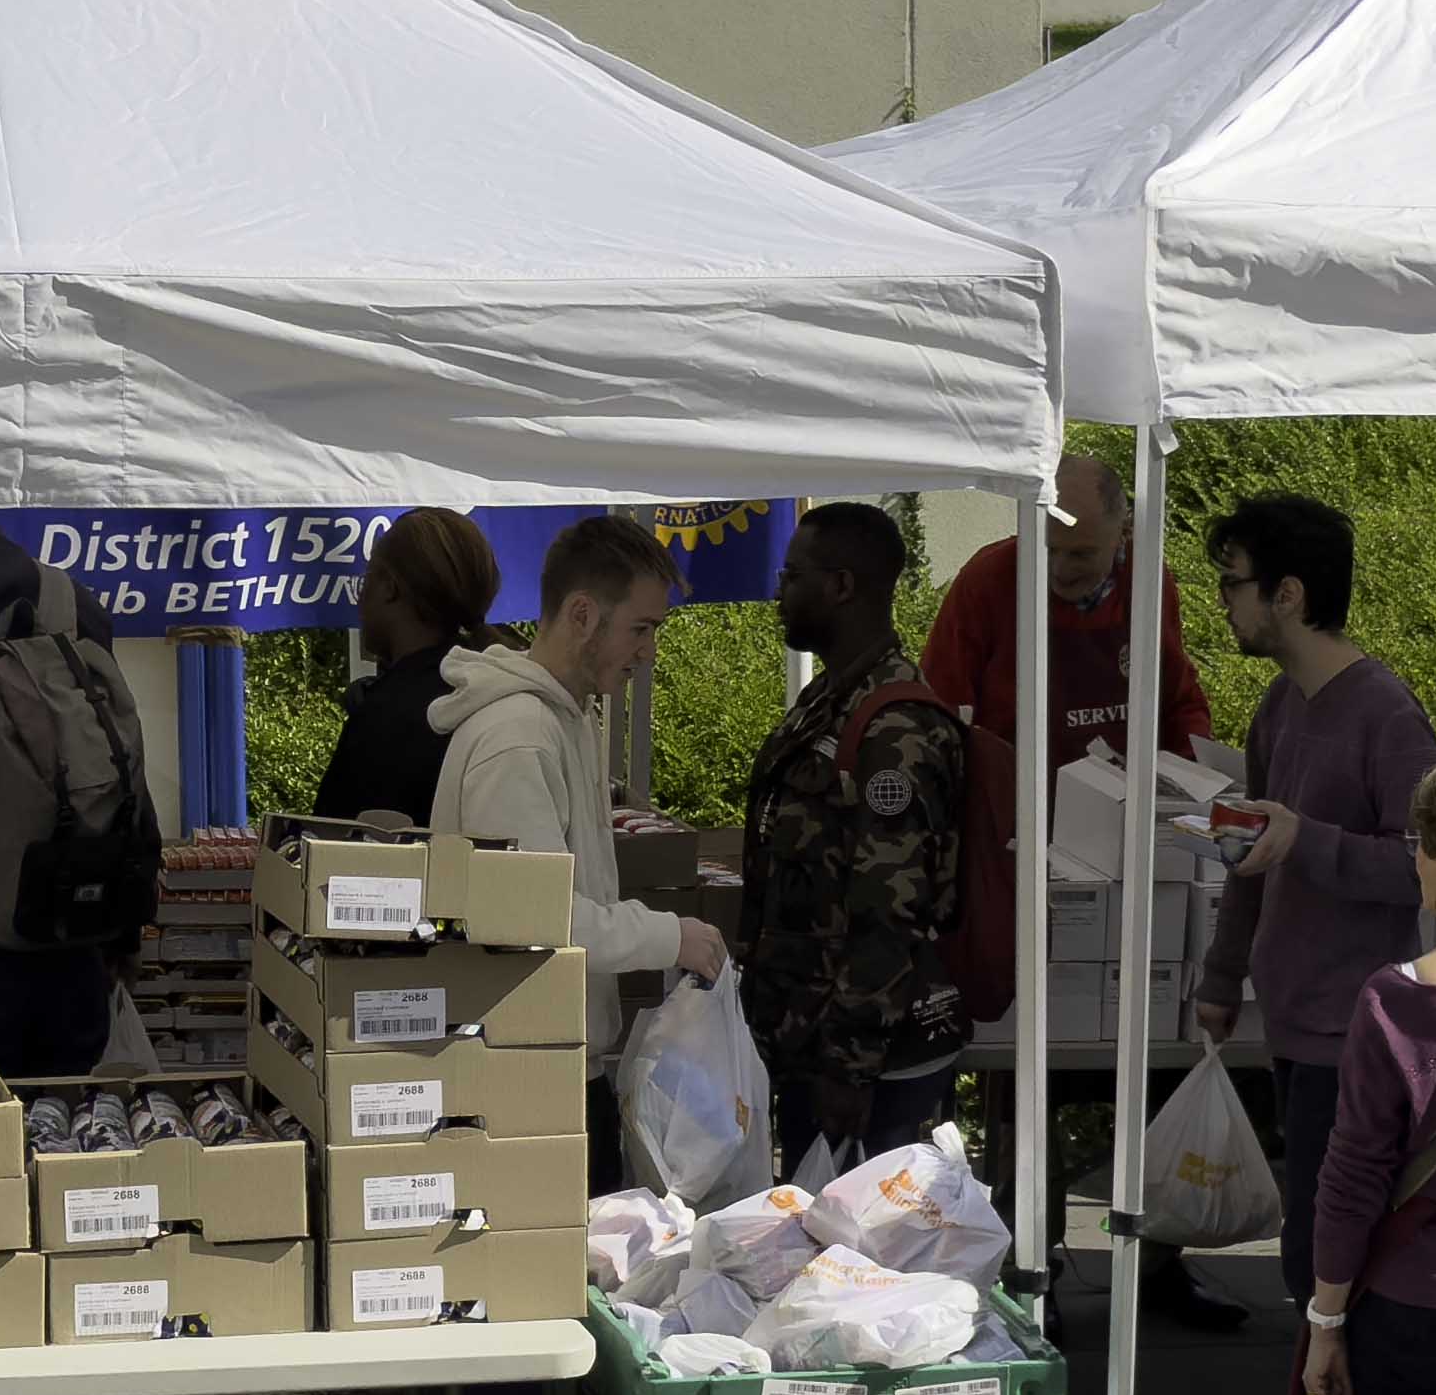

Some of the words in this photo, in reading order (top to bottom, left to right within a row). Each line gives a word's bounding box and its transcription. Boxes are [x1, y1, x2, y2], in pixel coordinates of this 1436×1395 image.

[38, 520, 250, 571] District
[165, 574, 365, 614] BETHUN
[1066, 703, 1129, 728] SERVI
[112, 1189, 140, 1201] 2688
